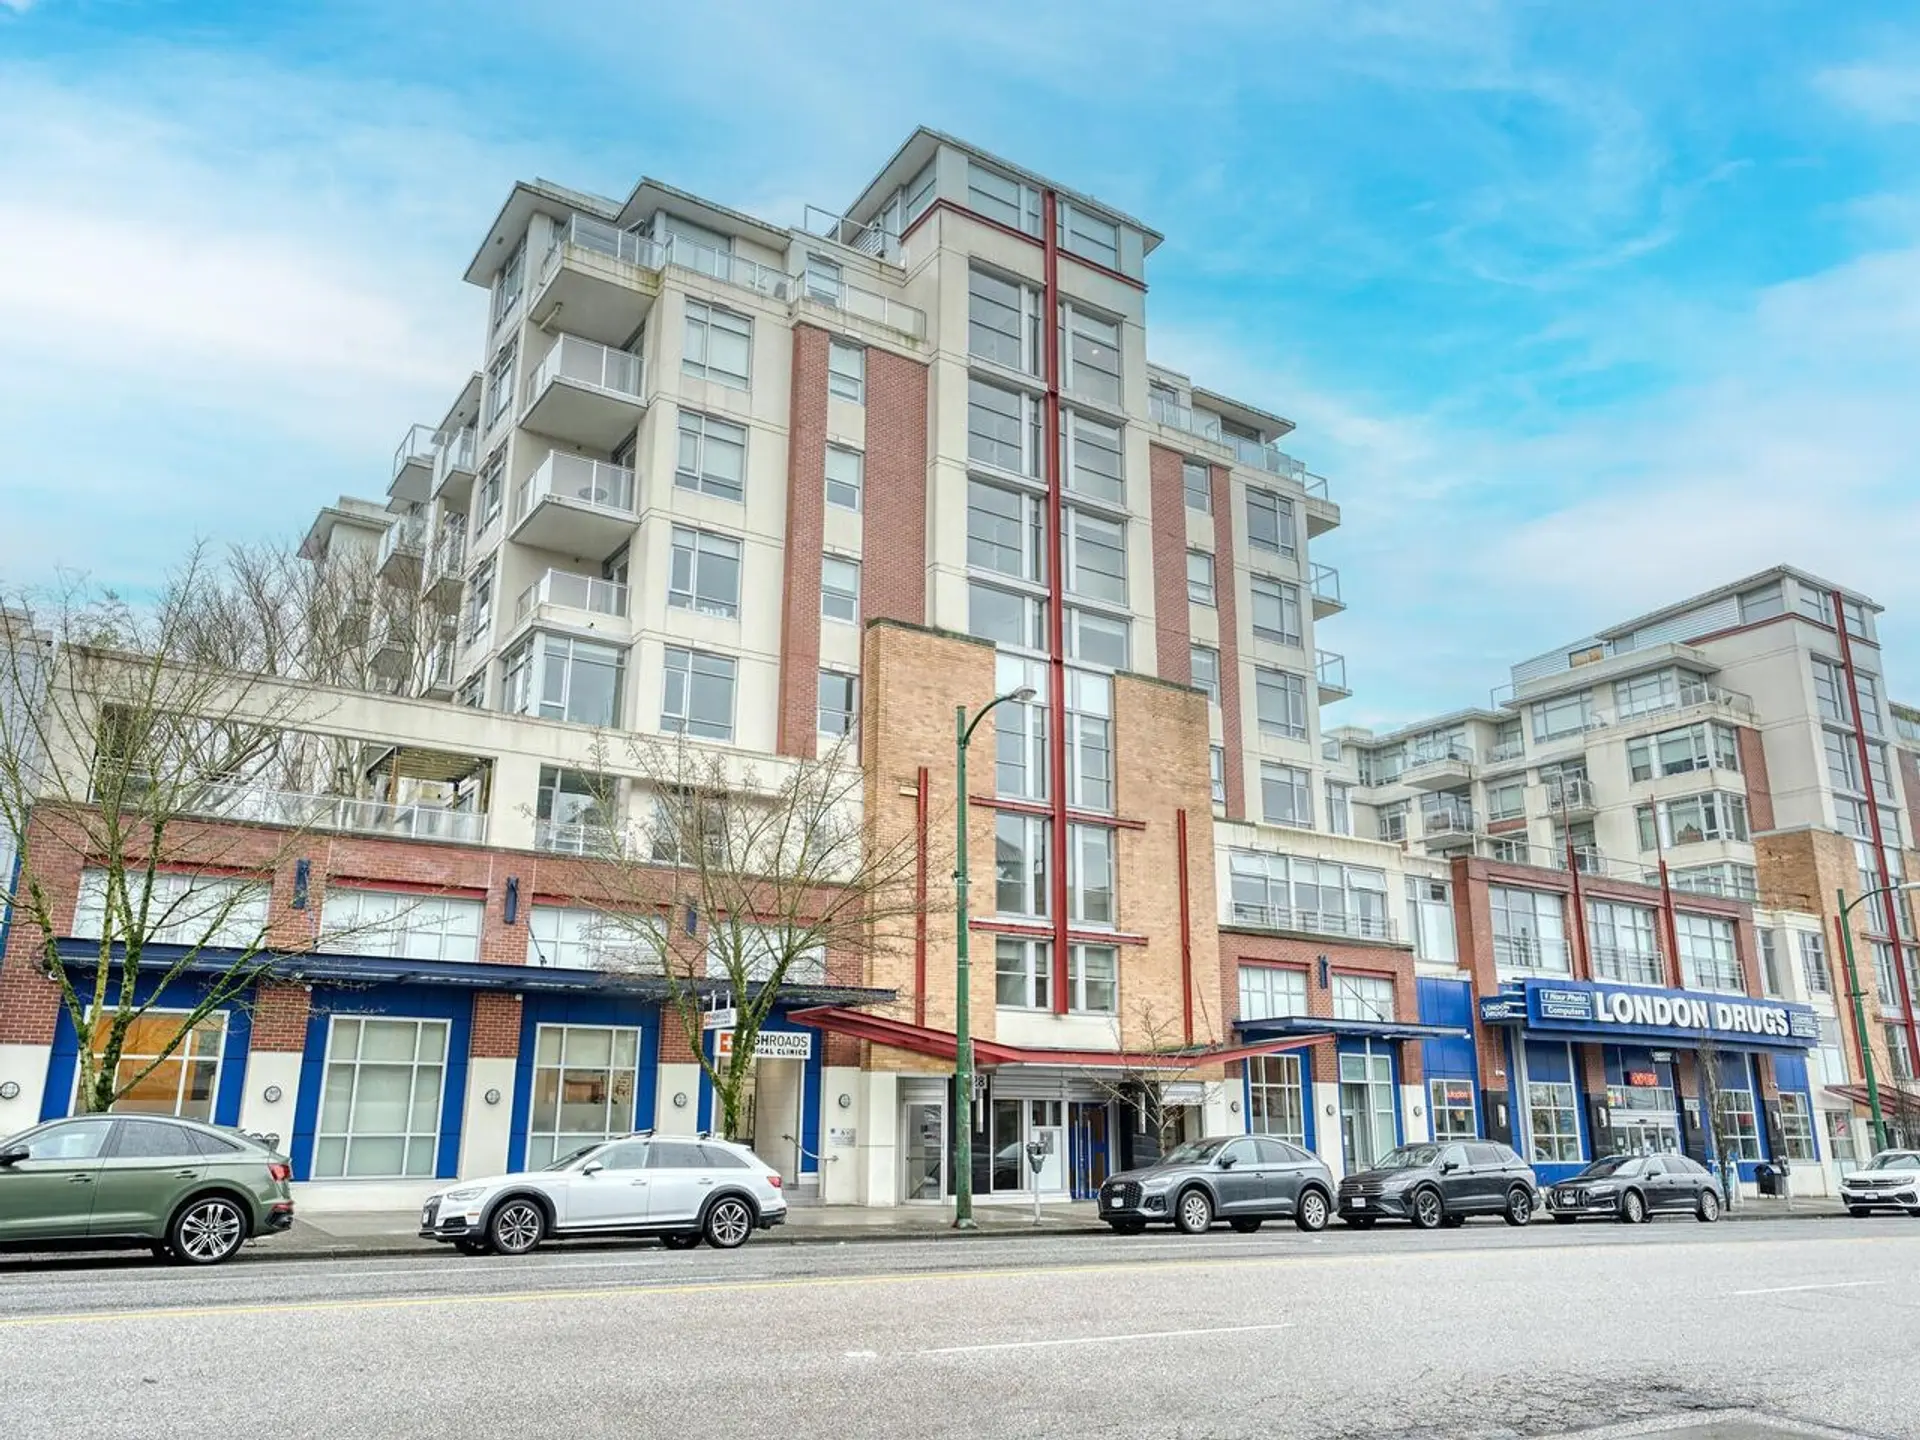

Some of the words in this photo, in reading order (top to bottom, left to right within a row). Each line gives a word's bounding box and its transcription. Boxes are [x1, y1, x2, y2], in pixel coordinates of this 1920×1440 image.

[1547, 1006, 1586, 1017] Computers
[1596, 991, 1710, 1028] LONDON
[1716, 1002, 1790, 1037] DRUGS
[754, 1034, 809, 1048] GHROADS
[777, 1048, 808, 1056] CLINICS
